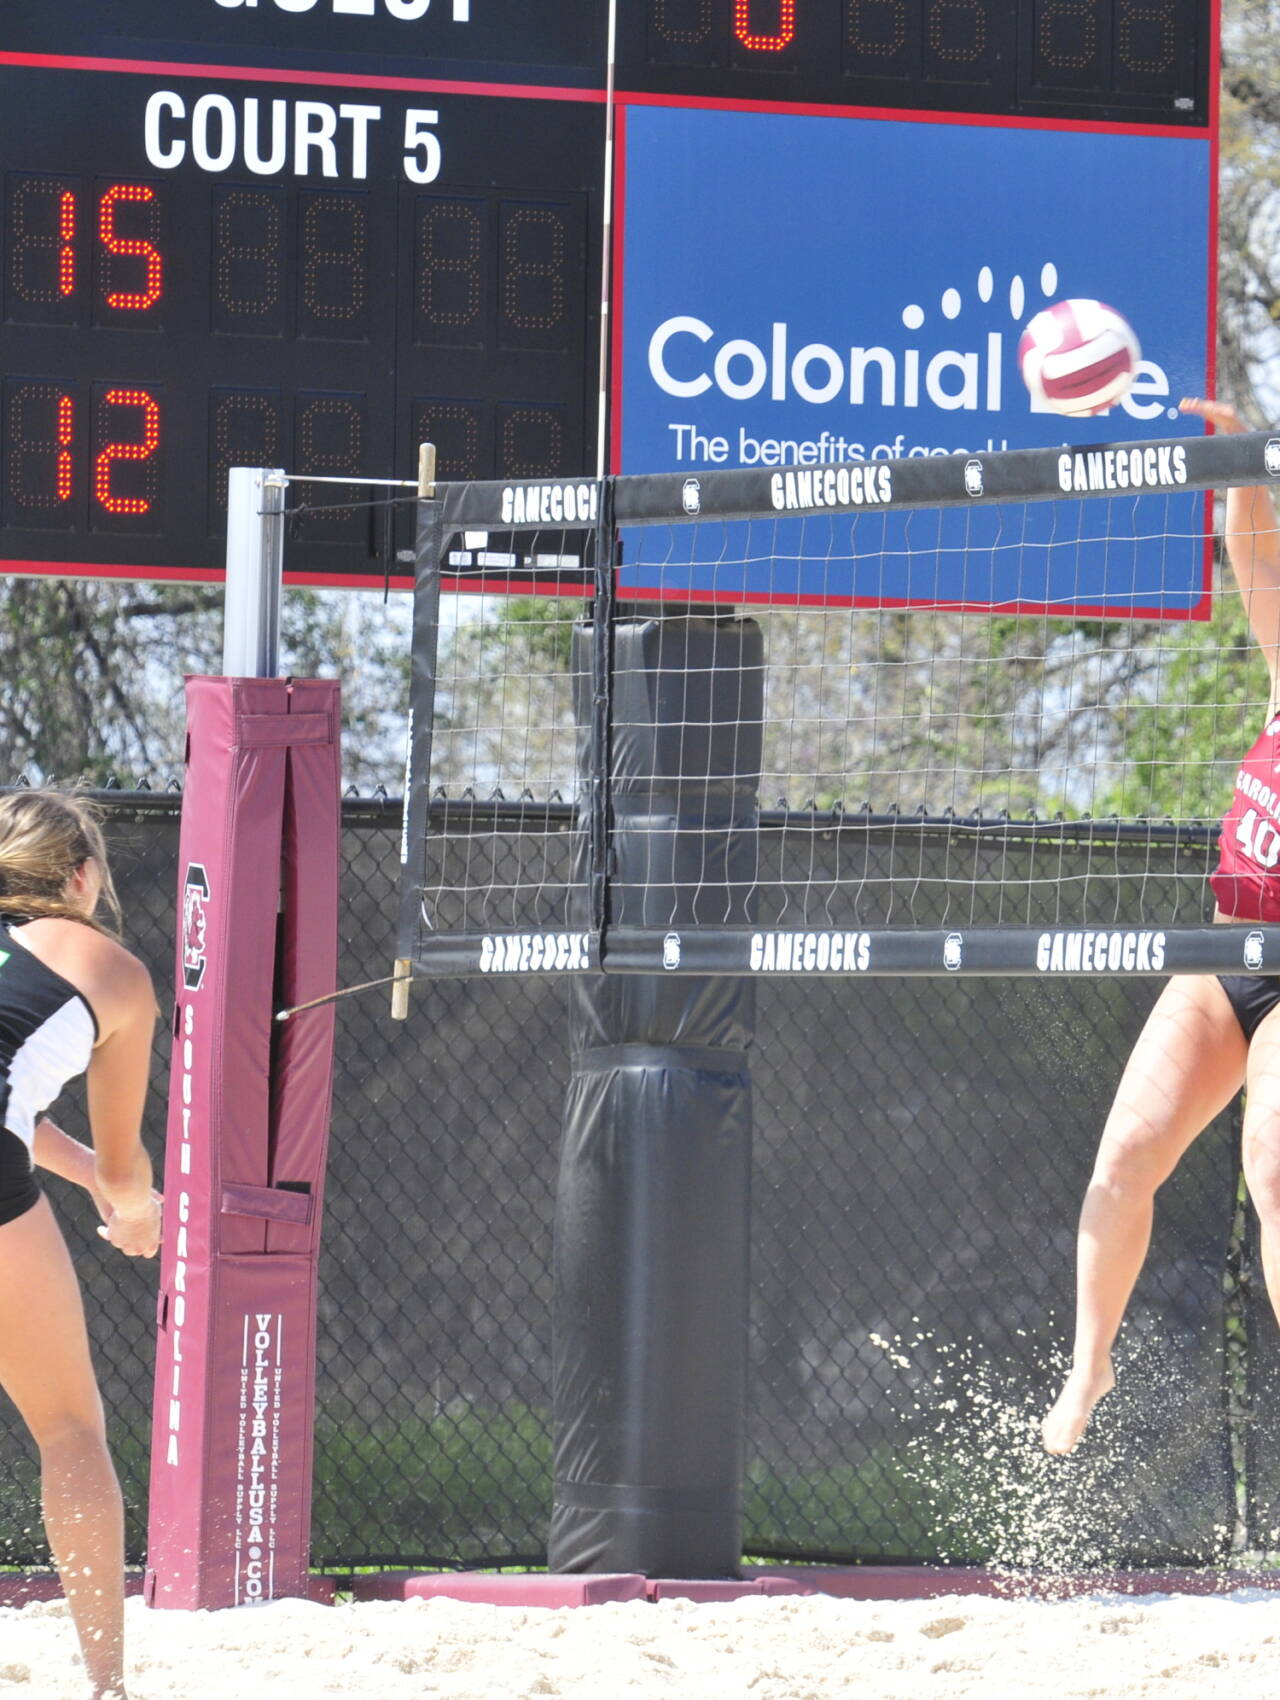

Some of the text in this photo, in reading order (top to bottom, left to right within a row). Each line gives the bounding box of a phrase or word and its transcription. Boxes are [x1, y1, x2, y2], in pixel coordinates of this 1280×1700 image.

[144, 91, 441, 183] COURT 5
[60, 185, 161, 309] 15
[648, 315, 1002, 412] Colonial
[58, 390, 159, 513] 12
[668, 423, 730, 463] The
[739, 427, 866, 466] benefits
[871, 434, 905, 461] of
[770, 465, 892, 511] GAMECOCKS
[1058, 445, 1187, 492] GAMECOCKS
[749, 932, 871, 971] GAMECOCKS
[1036, 931, 1166, 972] GAMECOCKS
[166, 1004, 194, 1467] SOUTH CAROLINA
